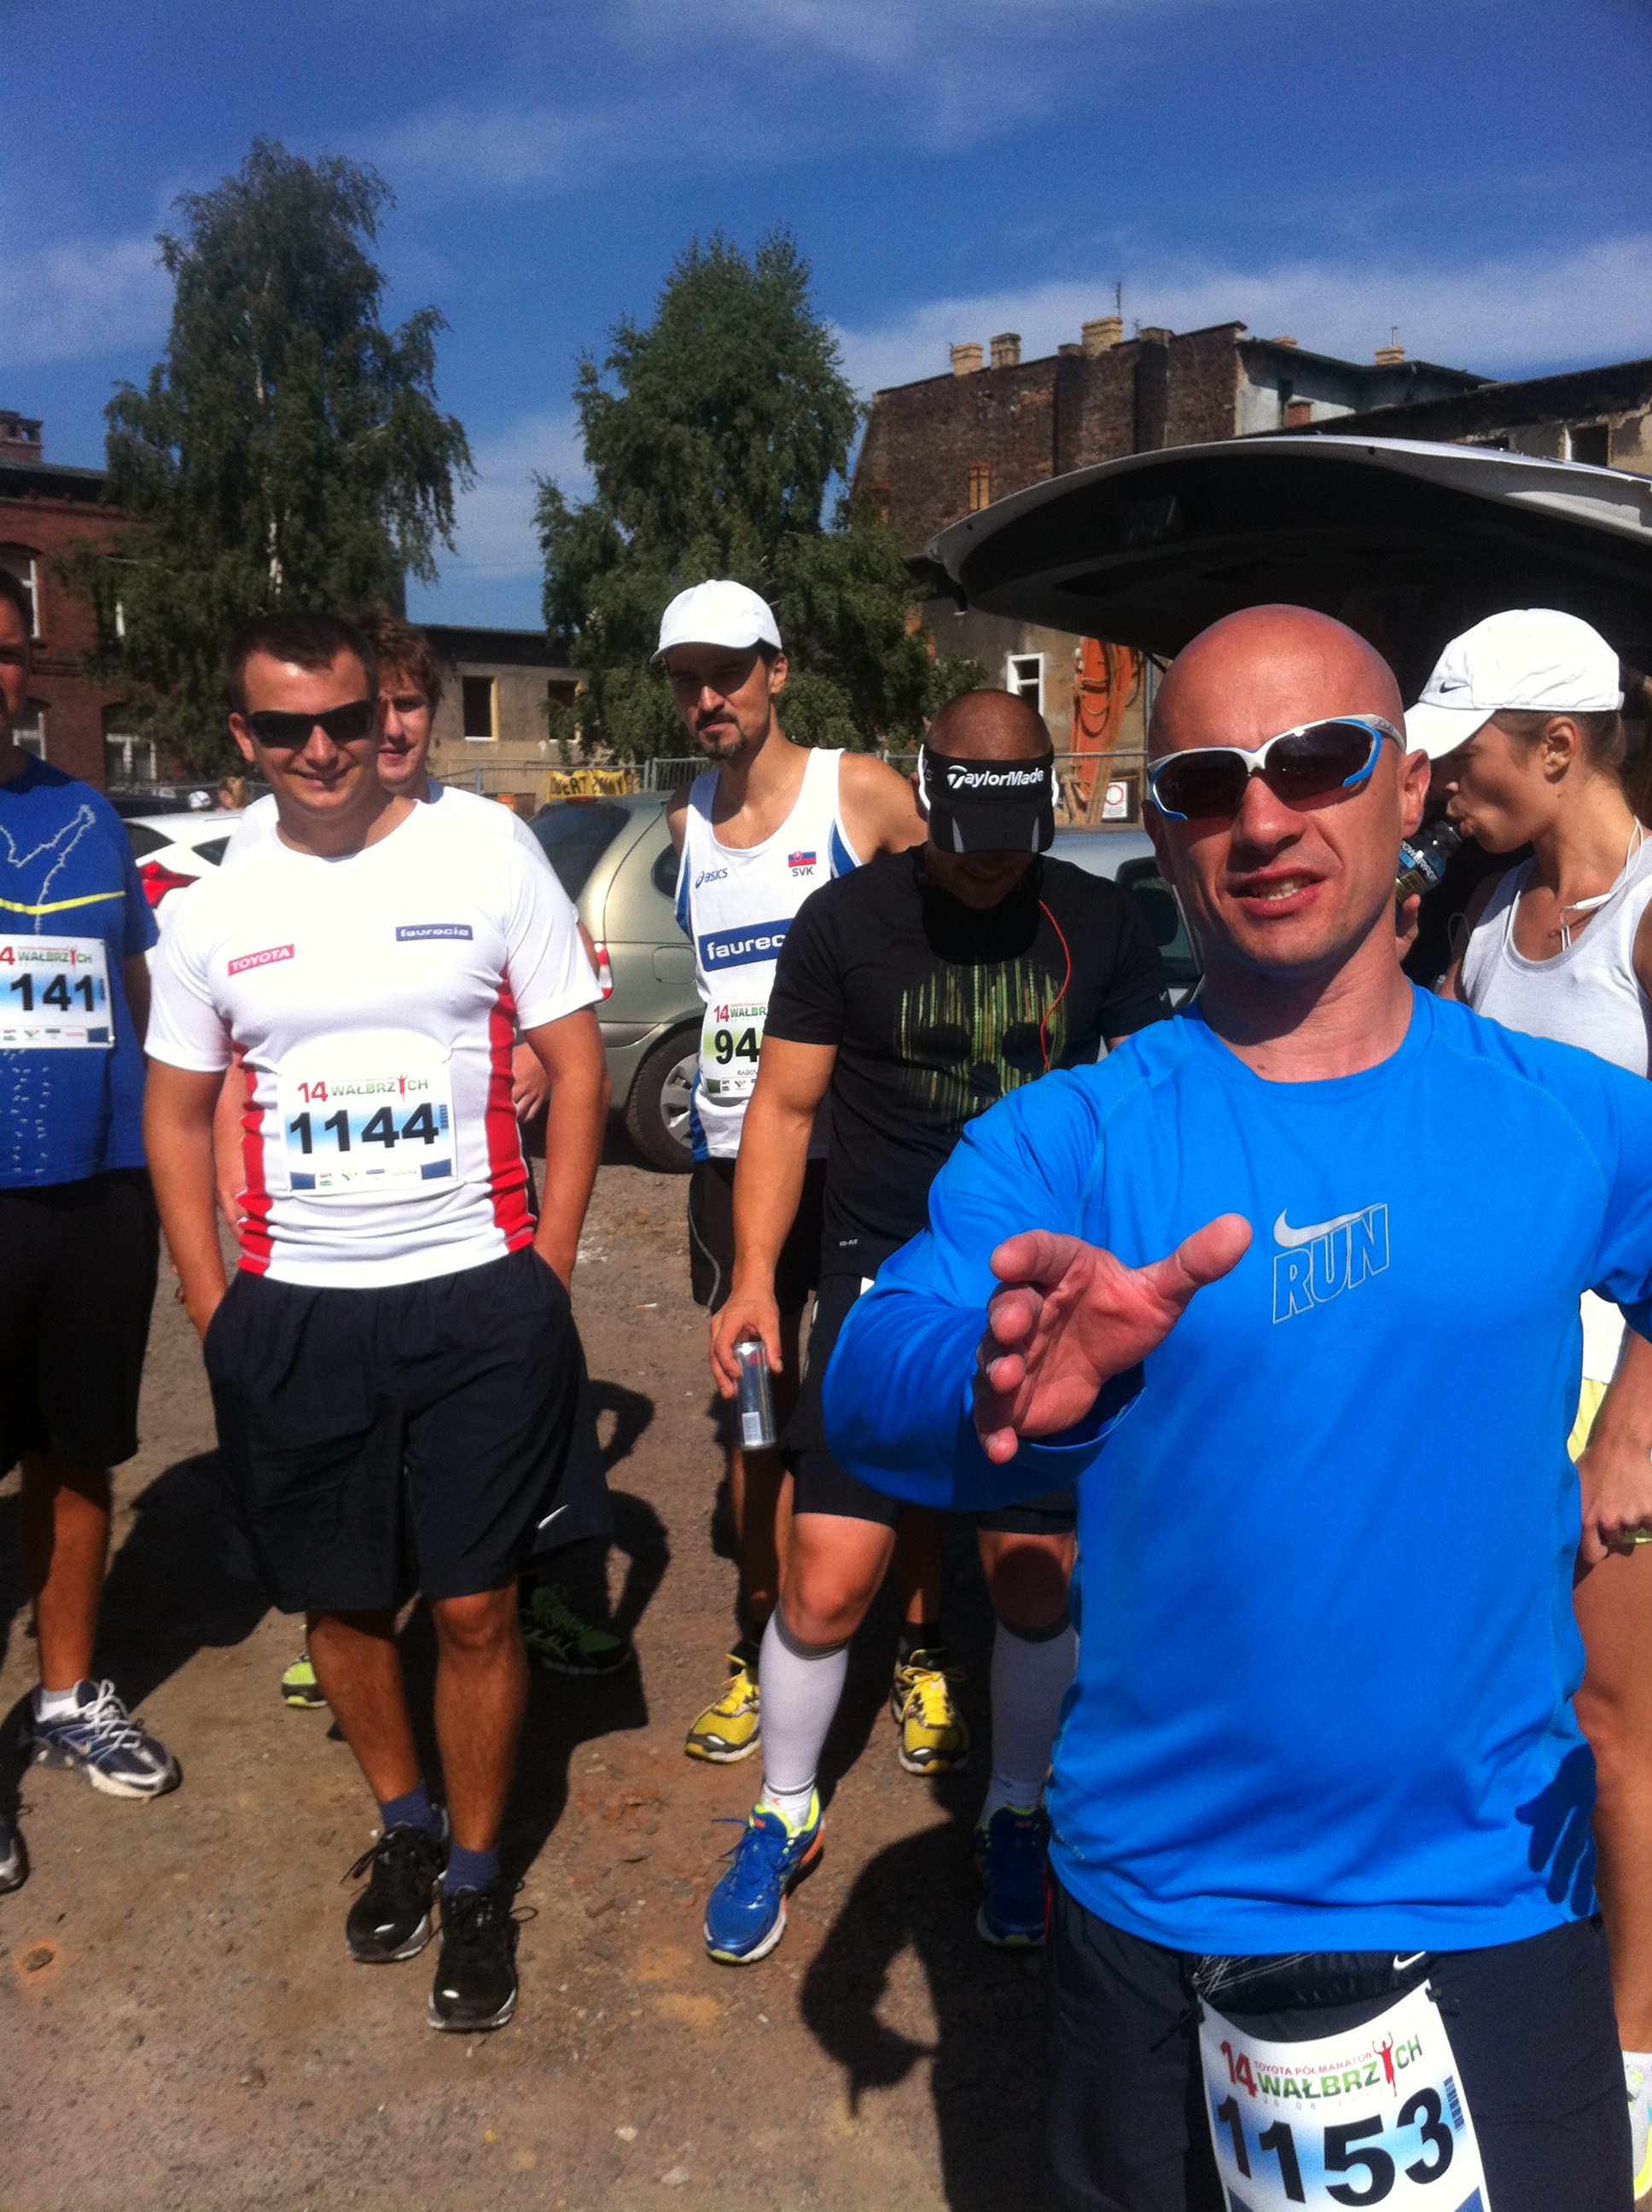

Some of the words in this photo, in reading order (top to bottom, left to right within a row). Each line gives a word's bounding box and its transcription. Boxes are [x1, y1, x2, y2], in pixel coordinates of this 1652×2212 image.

[946, 765, 1044, 789] TaylorMade
[704, 868, 728, 882] asics
[792, 867, 814, 877] SVK
[399, 927, 469, 939] faurecia
[230, 946, 291, 972] TOYOTA
[707, 934, 787, 961] faurec
[10, 973, 94, 1012] 141
[713, 1004, 730, 1022] 14
[714, 1027, 760, 1065] 94
[298, 1080, 329, 1103] 14
[289, 1102, 439, 1155] 1144
[1272, 1202, 1390, 1324] RUN
[1220, 2040, 1258, 2098] 14
[1254, 2060, 1293, 2076] TOYOTA
[1216, 2087, 1454, 2208] 1153
